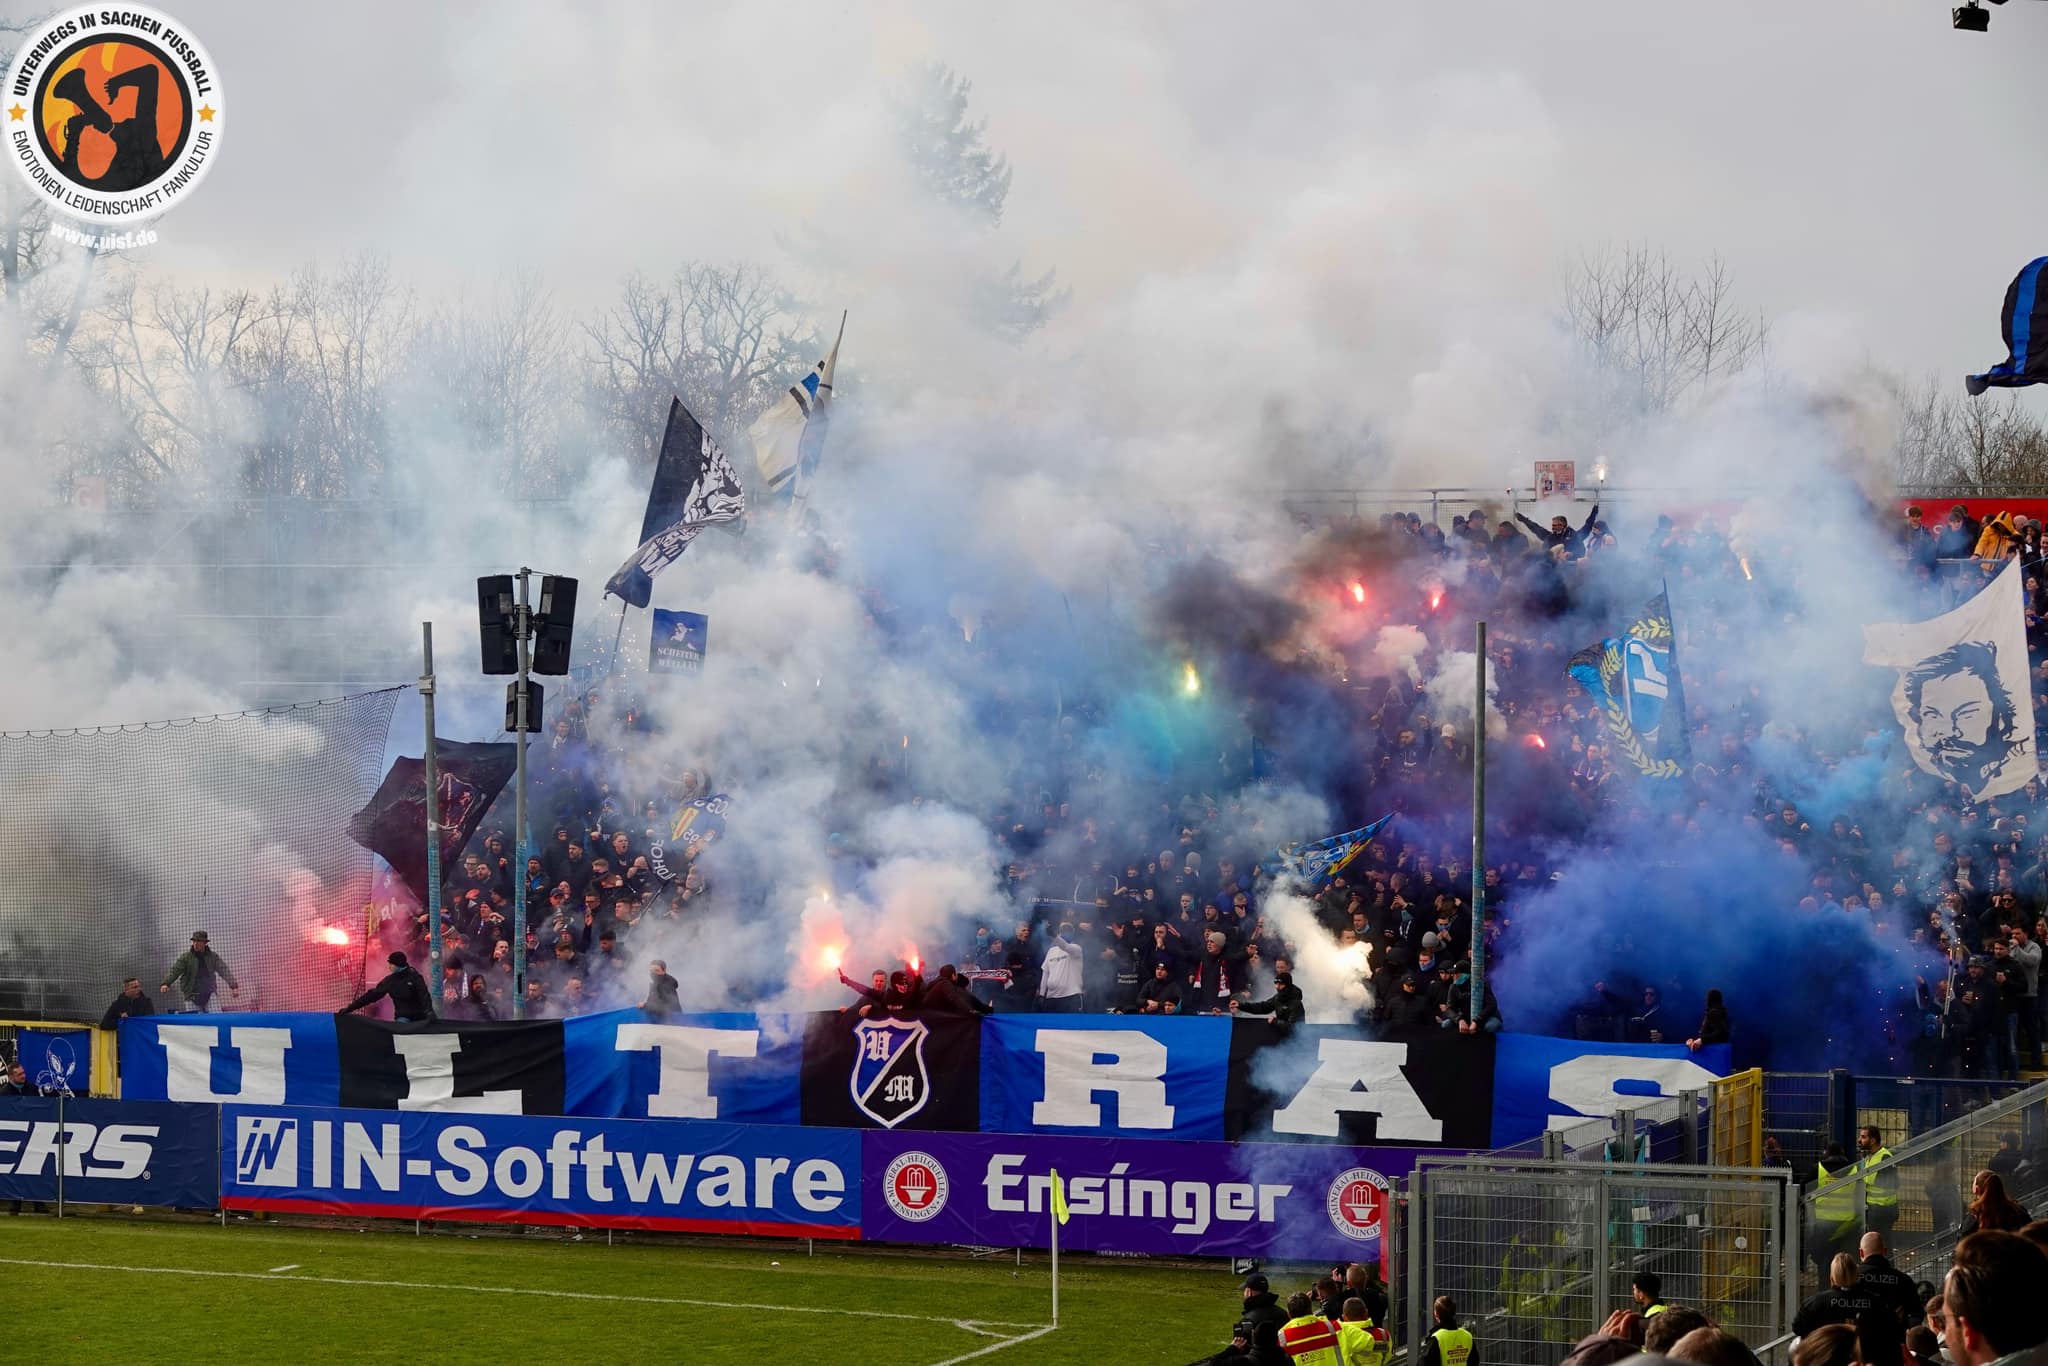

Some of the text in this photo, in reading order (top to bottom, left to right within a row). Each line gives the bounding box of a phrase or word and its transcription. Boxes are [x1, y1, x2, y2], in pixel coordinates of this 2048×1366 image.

[312, 1119, 846, 1213] IN-Software
[894, 1202, 938, 1219] ENSINGEN
[1857, 1273, 1899, 1285] POLIZEI
[1830, 1298, 1871, 1309] POLIZEI
